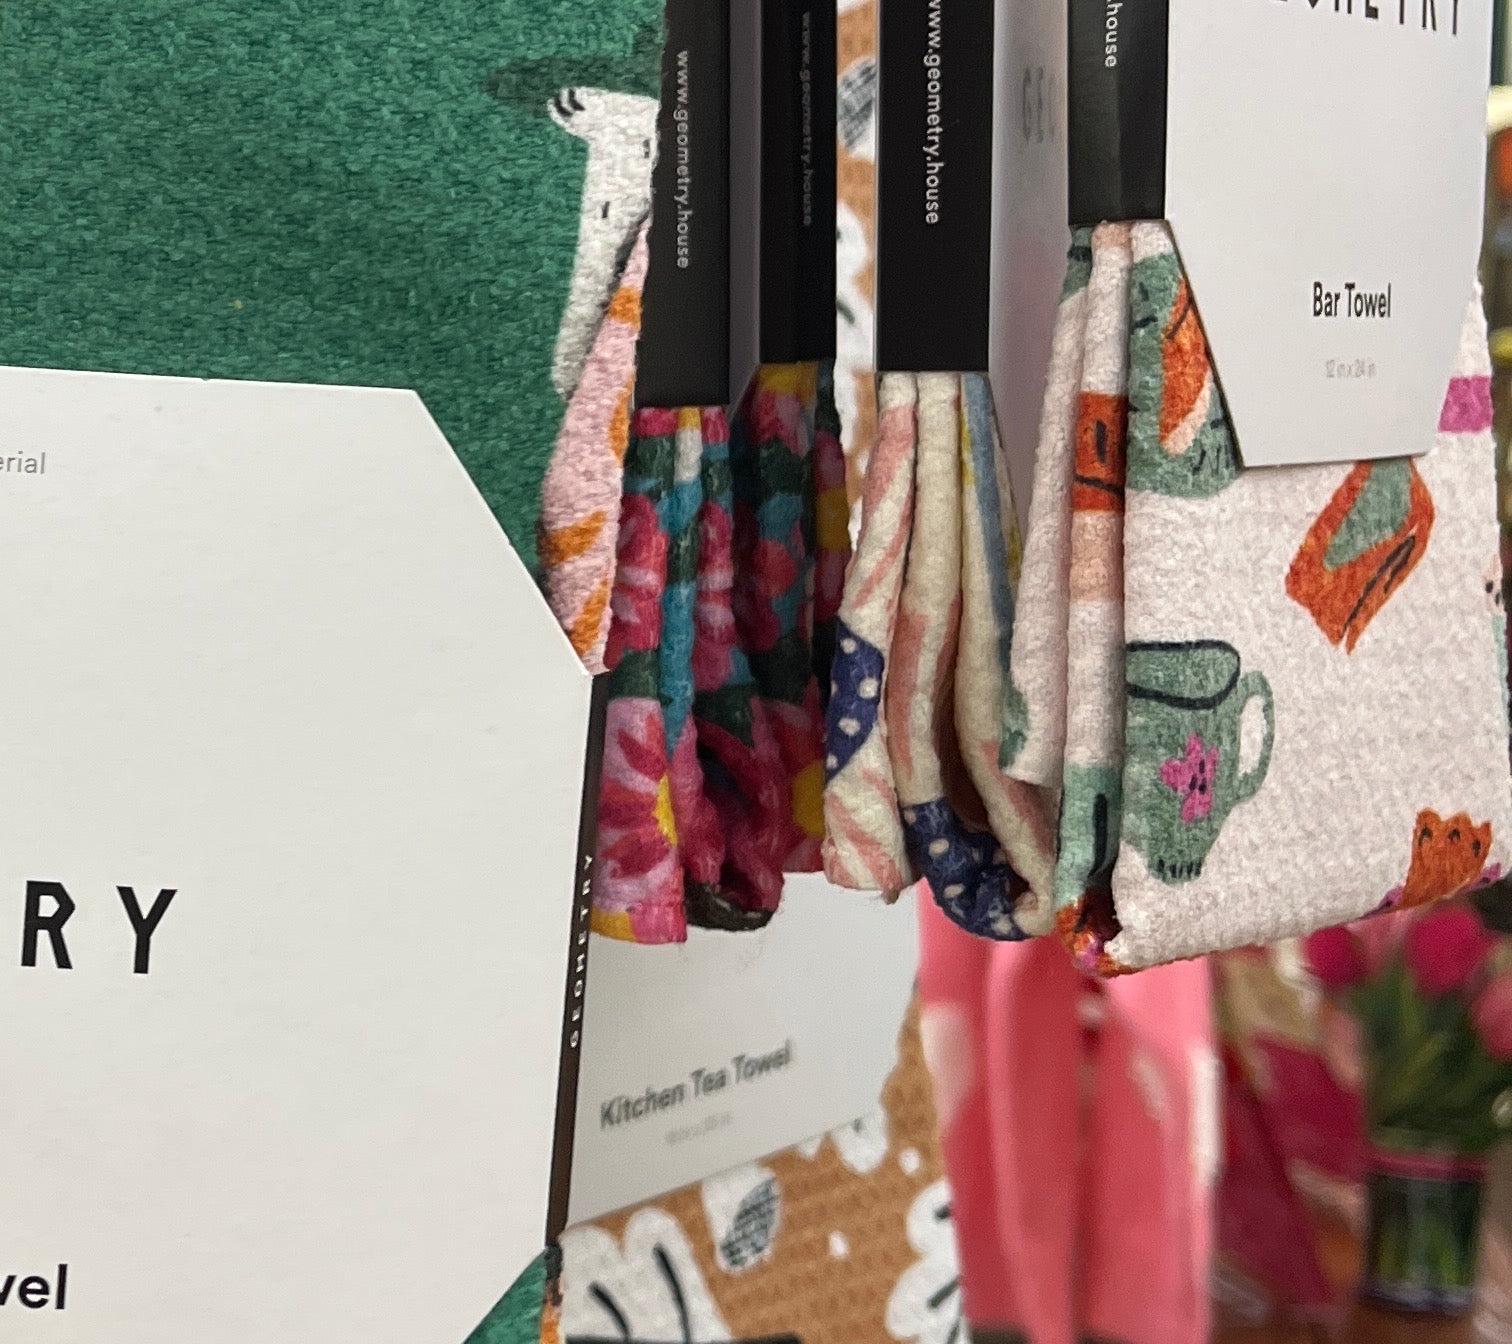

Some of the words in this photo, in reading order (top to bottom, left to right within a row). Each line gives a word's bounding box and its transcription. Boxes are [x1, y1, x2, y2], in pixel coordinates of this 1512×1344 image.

[673, 49, 693, 270] www.geometry.house
[1312, 280, 1341, 317] Bar
[1343, 281, 1392, 319] Towel
[599, 1083, 686, 1130] Kitchen
[690, 1067, 727, 1099] Tea
[731, 1038, 792, 1085] Towel
